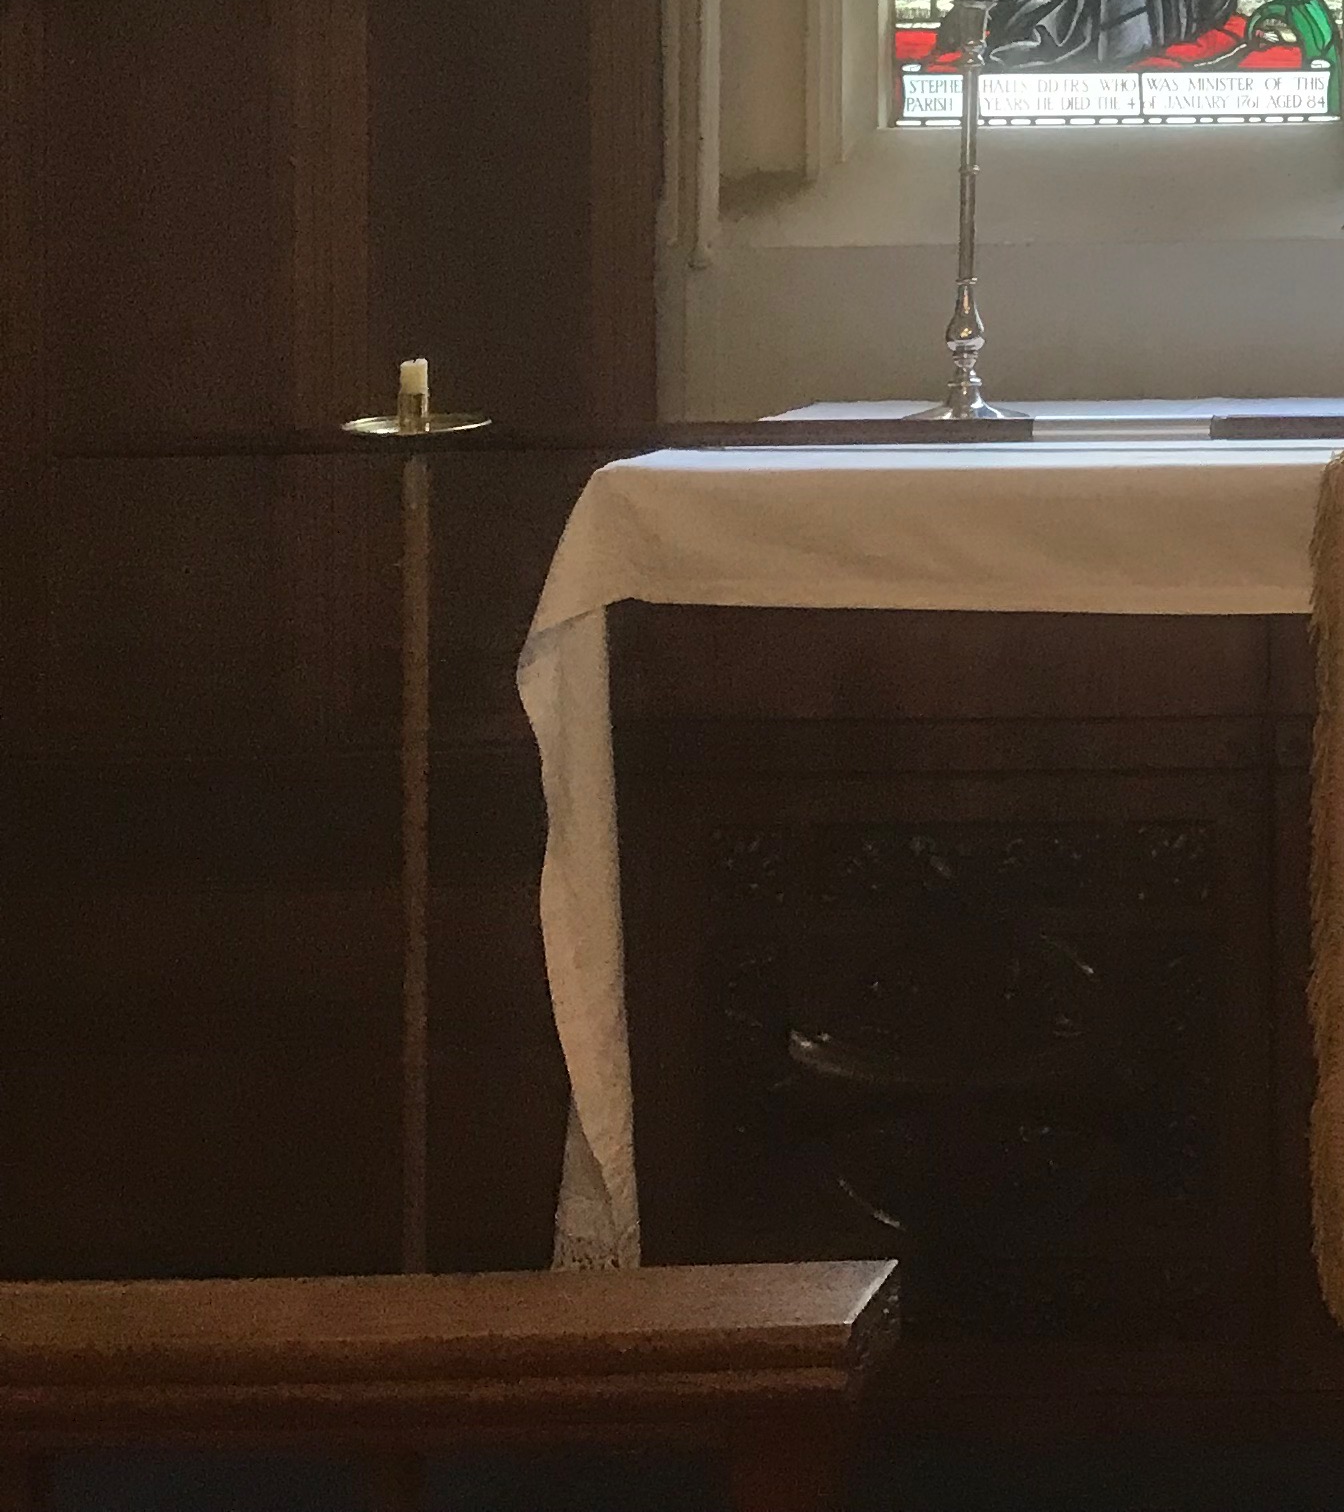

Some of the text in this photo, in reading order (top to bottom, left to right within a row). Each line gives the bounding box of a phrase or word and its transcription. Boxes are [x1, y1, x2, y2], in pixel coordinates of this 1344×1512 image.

[909, 78, 963, 94] STEPHE
[1099, 78, 1137, 93] WHO
[1146, 77, 1179, 92] WAS
[1187, 77, 1254, 92] MINISTER
[1264, 77, 1283, 91] OF
[1296, 76, 1325, 91] THIS
[905, 97, 953, 113] PARISH
[983, 96, 1031, 111] YEARS
[1036, 96, 1054, 111] HE
[1061, 96, 1091, 111] DIED
[1164, 95, 1230, 110] JANUARY
[1236, 95, 1260, 109] 1761
[1267, 94, 1303, 109] AGED
[1306, 94, 1326, 109] 84
